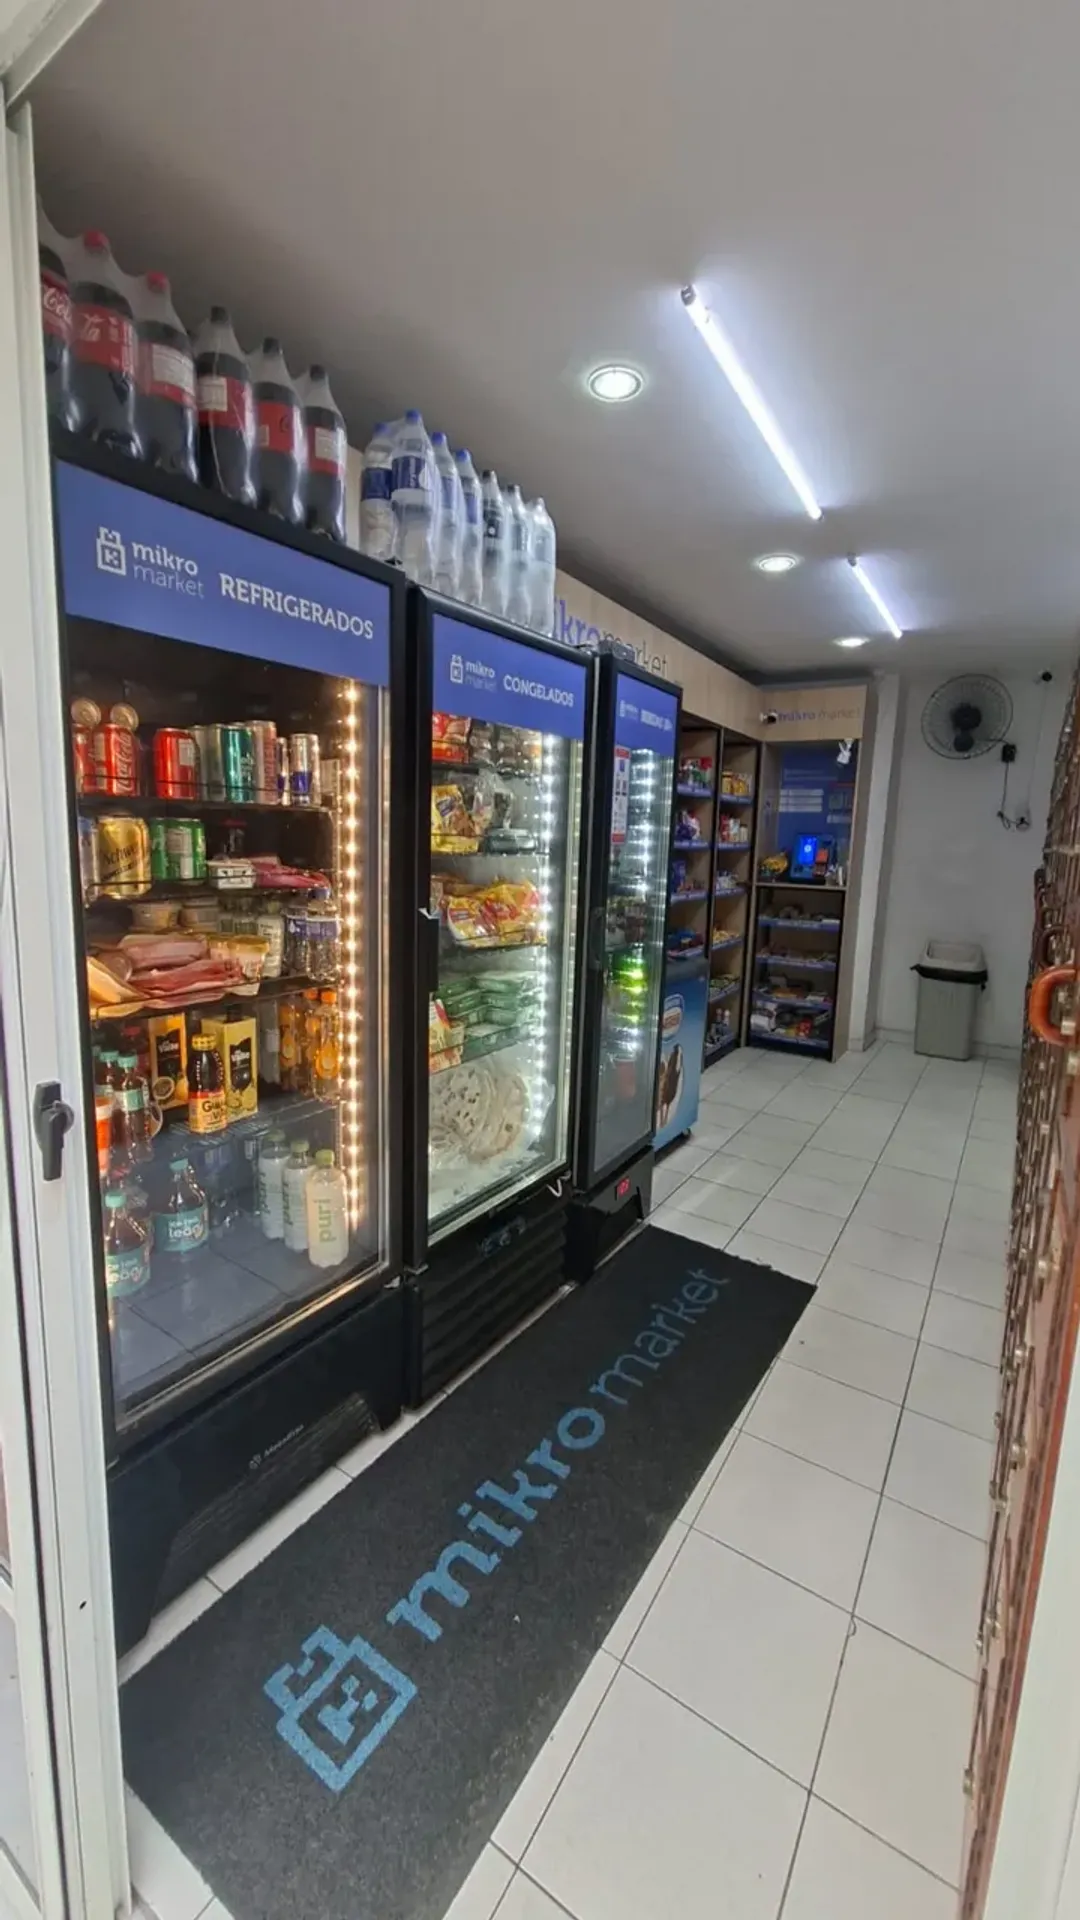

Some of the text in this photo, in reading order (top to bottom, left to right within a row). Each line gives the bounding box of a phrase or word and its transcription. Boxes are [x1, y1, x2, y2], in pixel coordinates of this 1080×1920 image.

[131, 541, 198, 577] mikro
[133, 563, 204, 598] market
[219, 572, 373, 640] REFRIGERADOS
[465, 660, 496, 679] mikro
[503, 673, 575, 708] CONGELADOS
[313, 1198, 337, 1242] puri
[387, 1266, 731, 1643] mikro market
